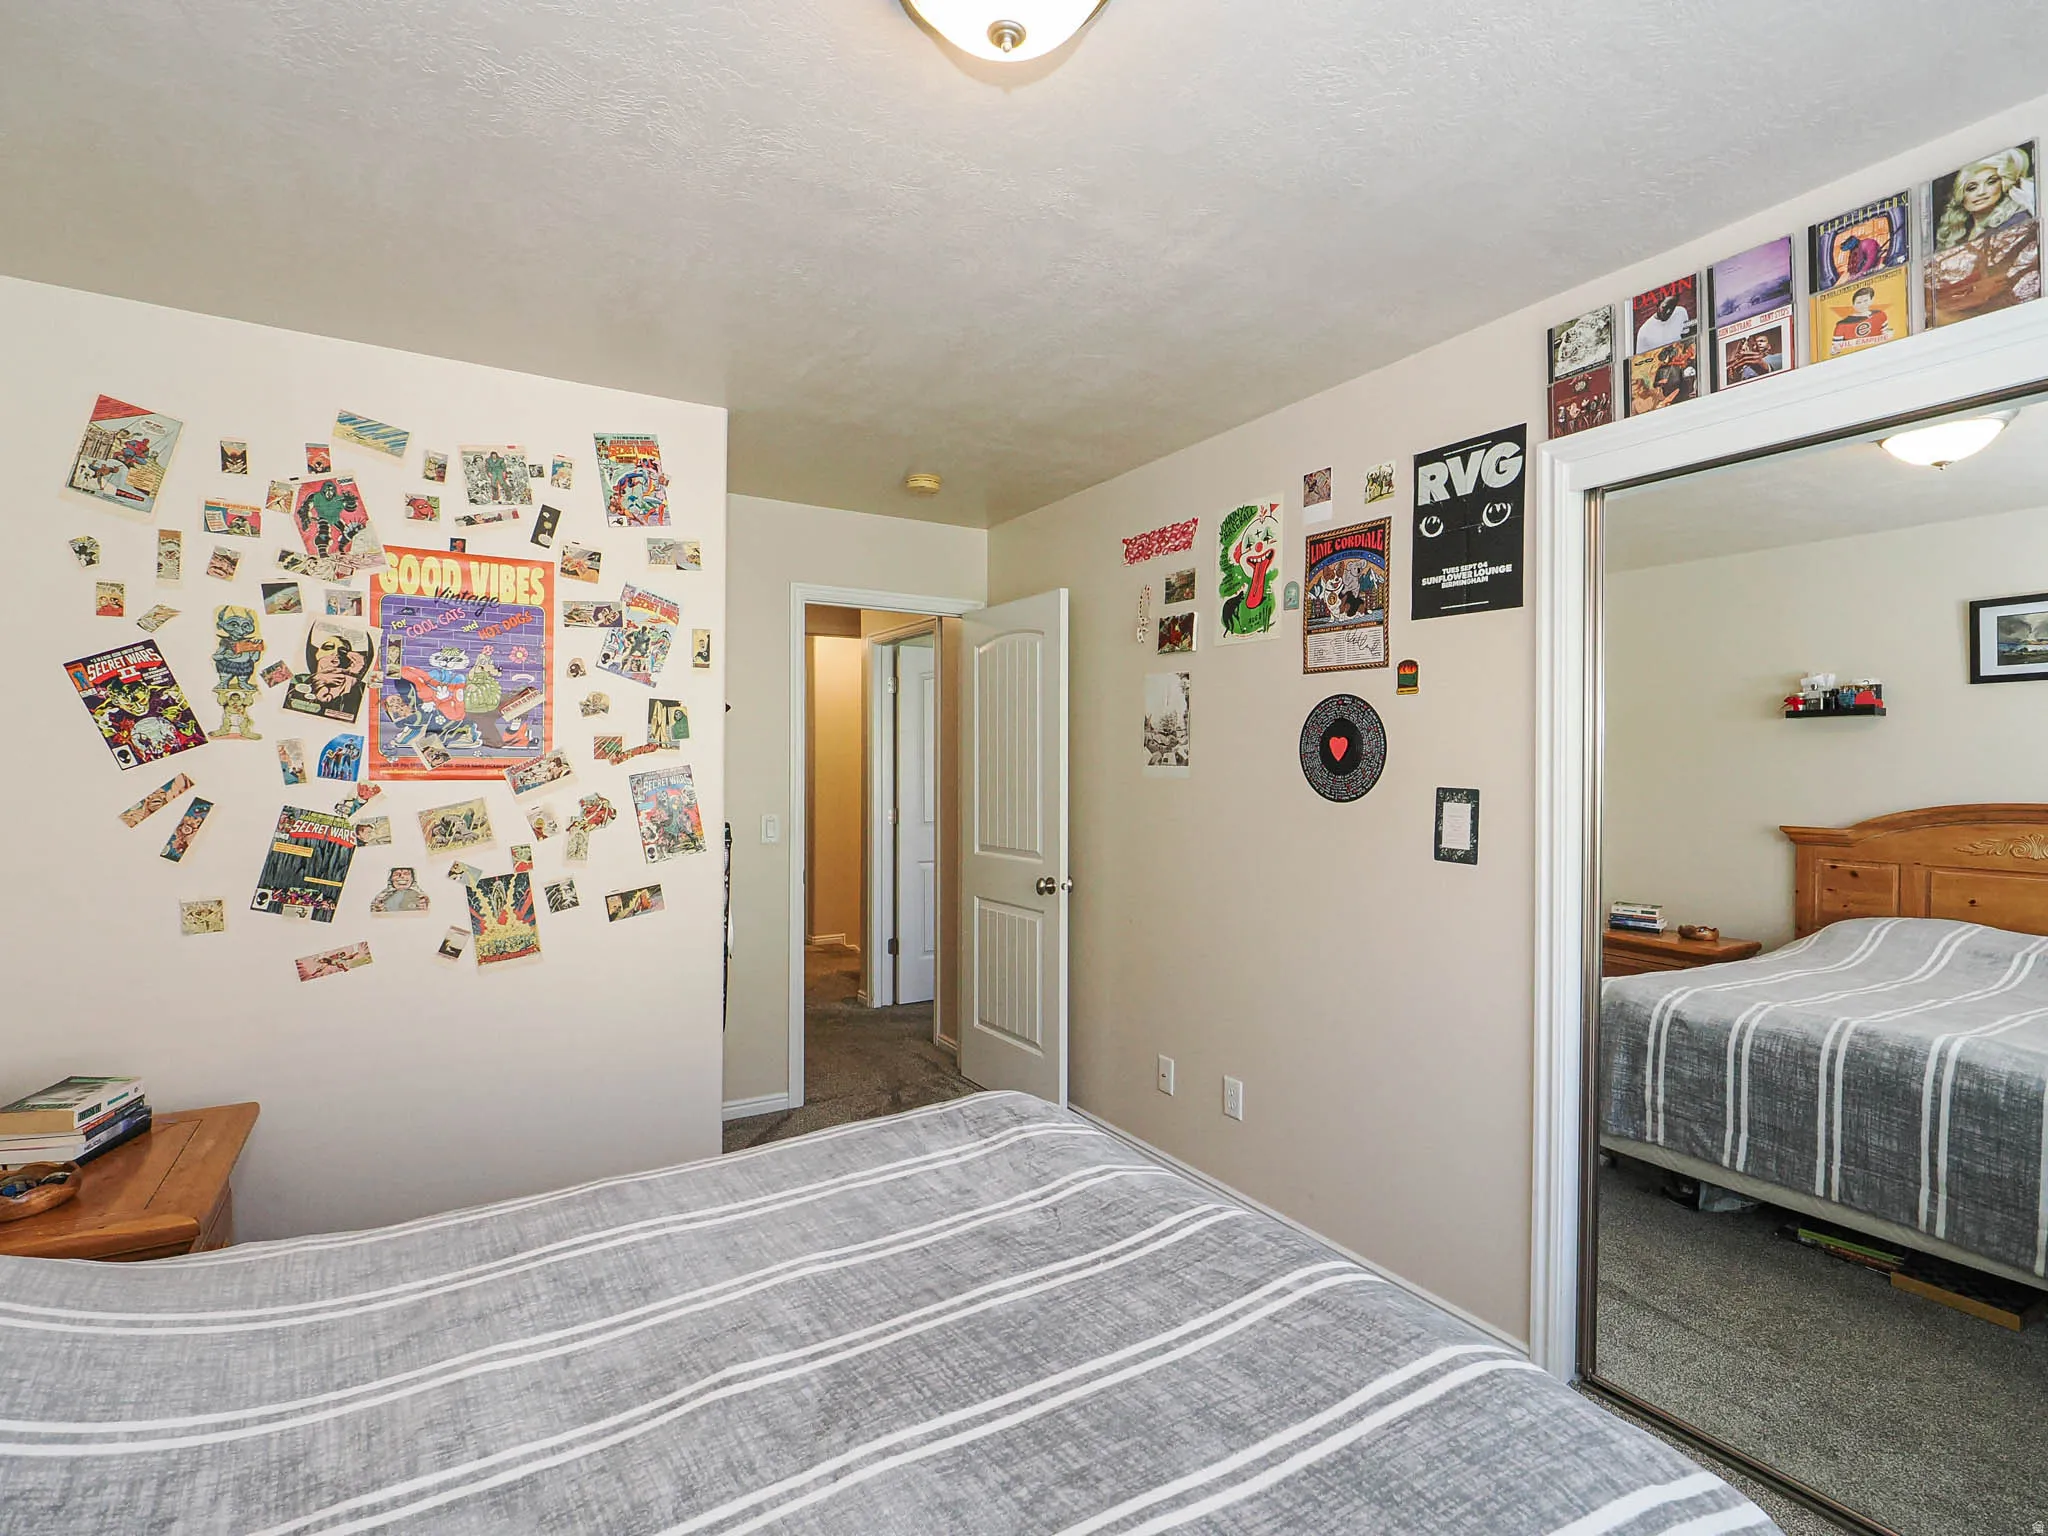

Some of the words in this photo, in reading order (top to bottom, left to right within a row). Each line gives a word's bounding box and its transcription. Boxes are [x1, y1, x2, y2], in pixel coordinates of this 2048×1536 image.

[1633, 276, 1692, 310] DAMN
[1418, 441, 1523, 506] RVG
[1311, 540, 1333, 564] LIME
[1334, 529, 1384, 551] CORDIALE
[379, 552, 462, 597] GOOD
[469, 561, 545, 606] VIBES
[1421, 570, 1473, 587] SUNFLOWER
[1473, 563, 1513, 577] LOUNGE
[1441, 575, 1489, 589] BIRMINGHAM
[1442, 566, 1460, 575] TUES
[1460, 562, 1478, 572] SEPT
[434, 586, 500, 617] Vintage
[391, 618, 407, 631] For
[406, 619, 438, 640] COOL
[438, 607, 466, 626] CATS
[461, 619, 480, 633] and
[477, 625, 503, 641] HOT
[501, 610, 534, 632] DOGS
[87, 656, 128, 682] SECRET
[127, 647, 164, 665] WARS
[116, 665, 141, 680] II
[289, 820, 329, 835] SECRET
[329, 825, 357, 845] WARS
